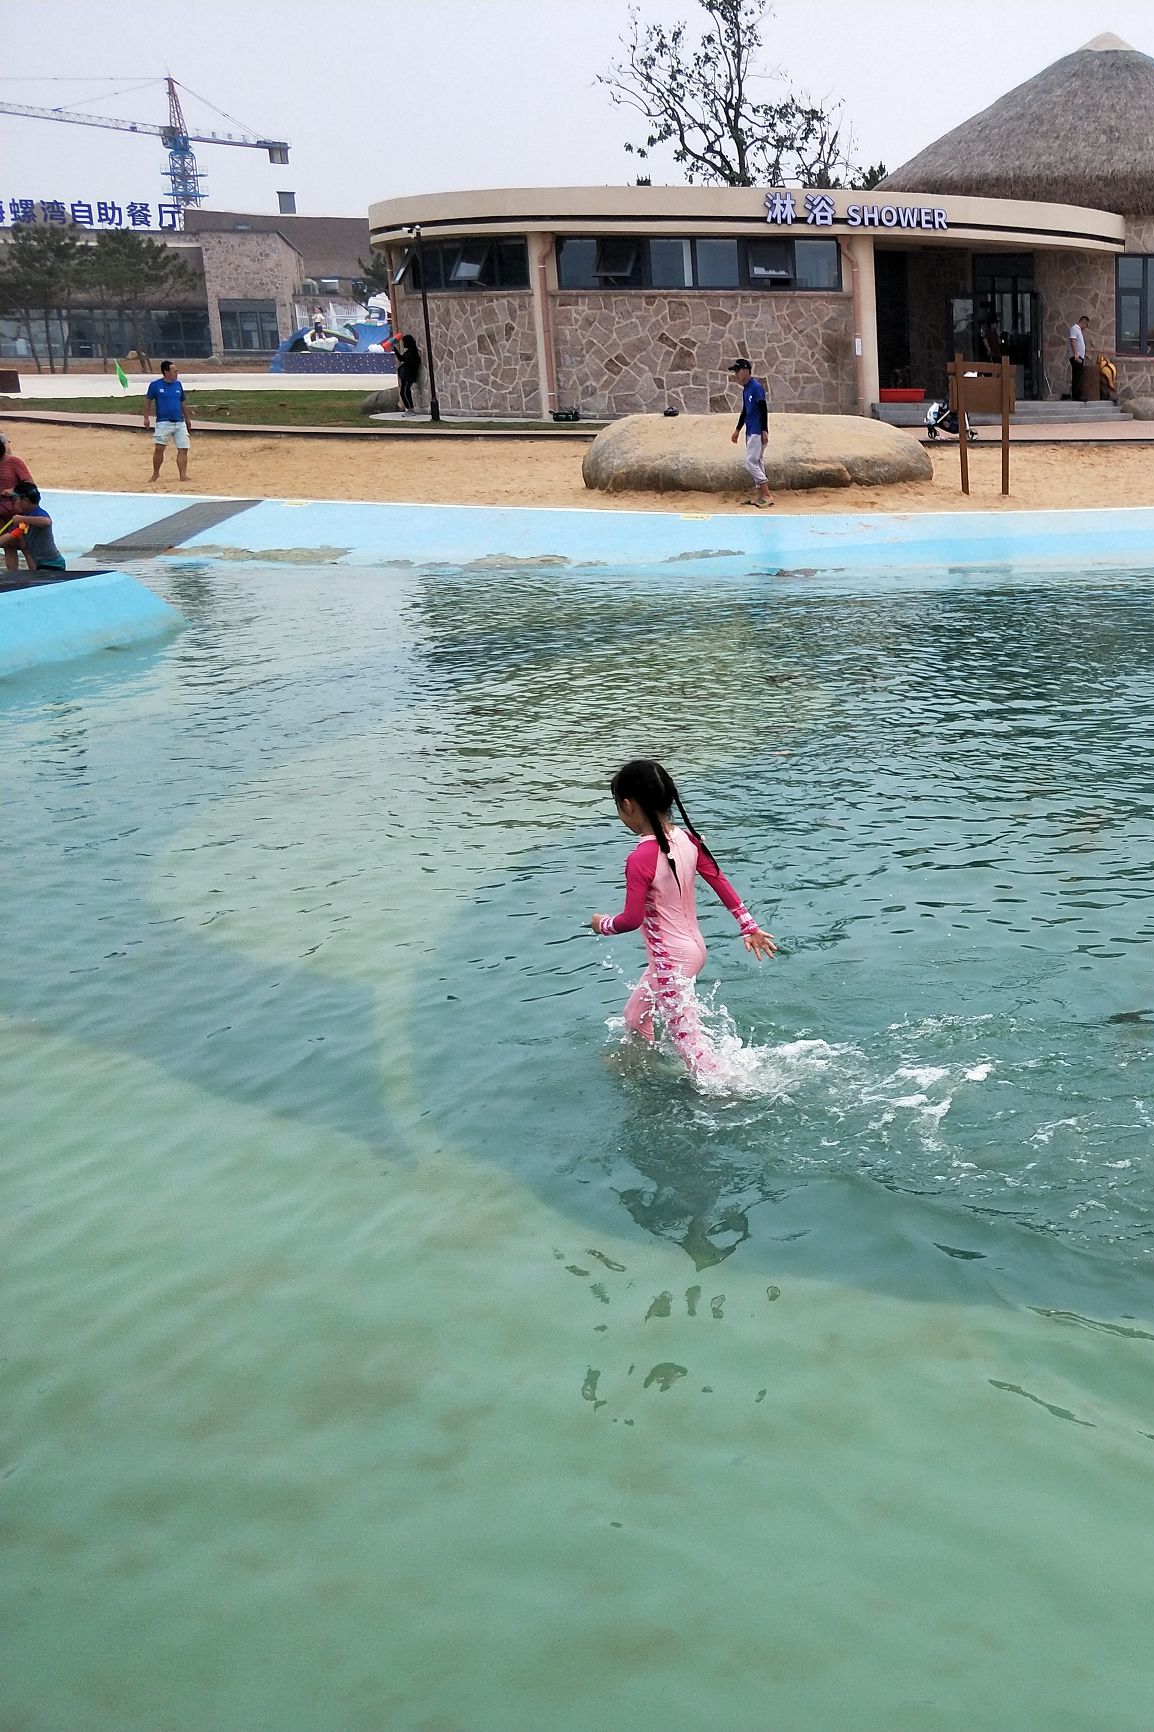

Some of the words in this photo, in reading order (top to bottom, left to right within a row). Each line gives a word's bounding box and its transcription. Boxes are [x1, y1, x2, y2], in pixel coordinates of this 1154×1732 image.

[0, 198, 182, 230] 螺湾自助餐厅
[764, 191, 836, 226] 淋浴
[847, 204, 949, 230] SHOWER
